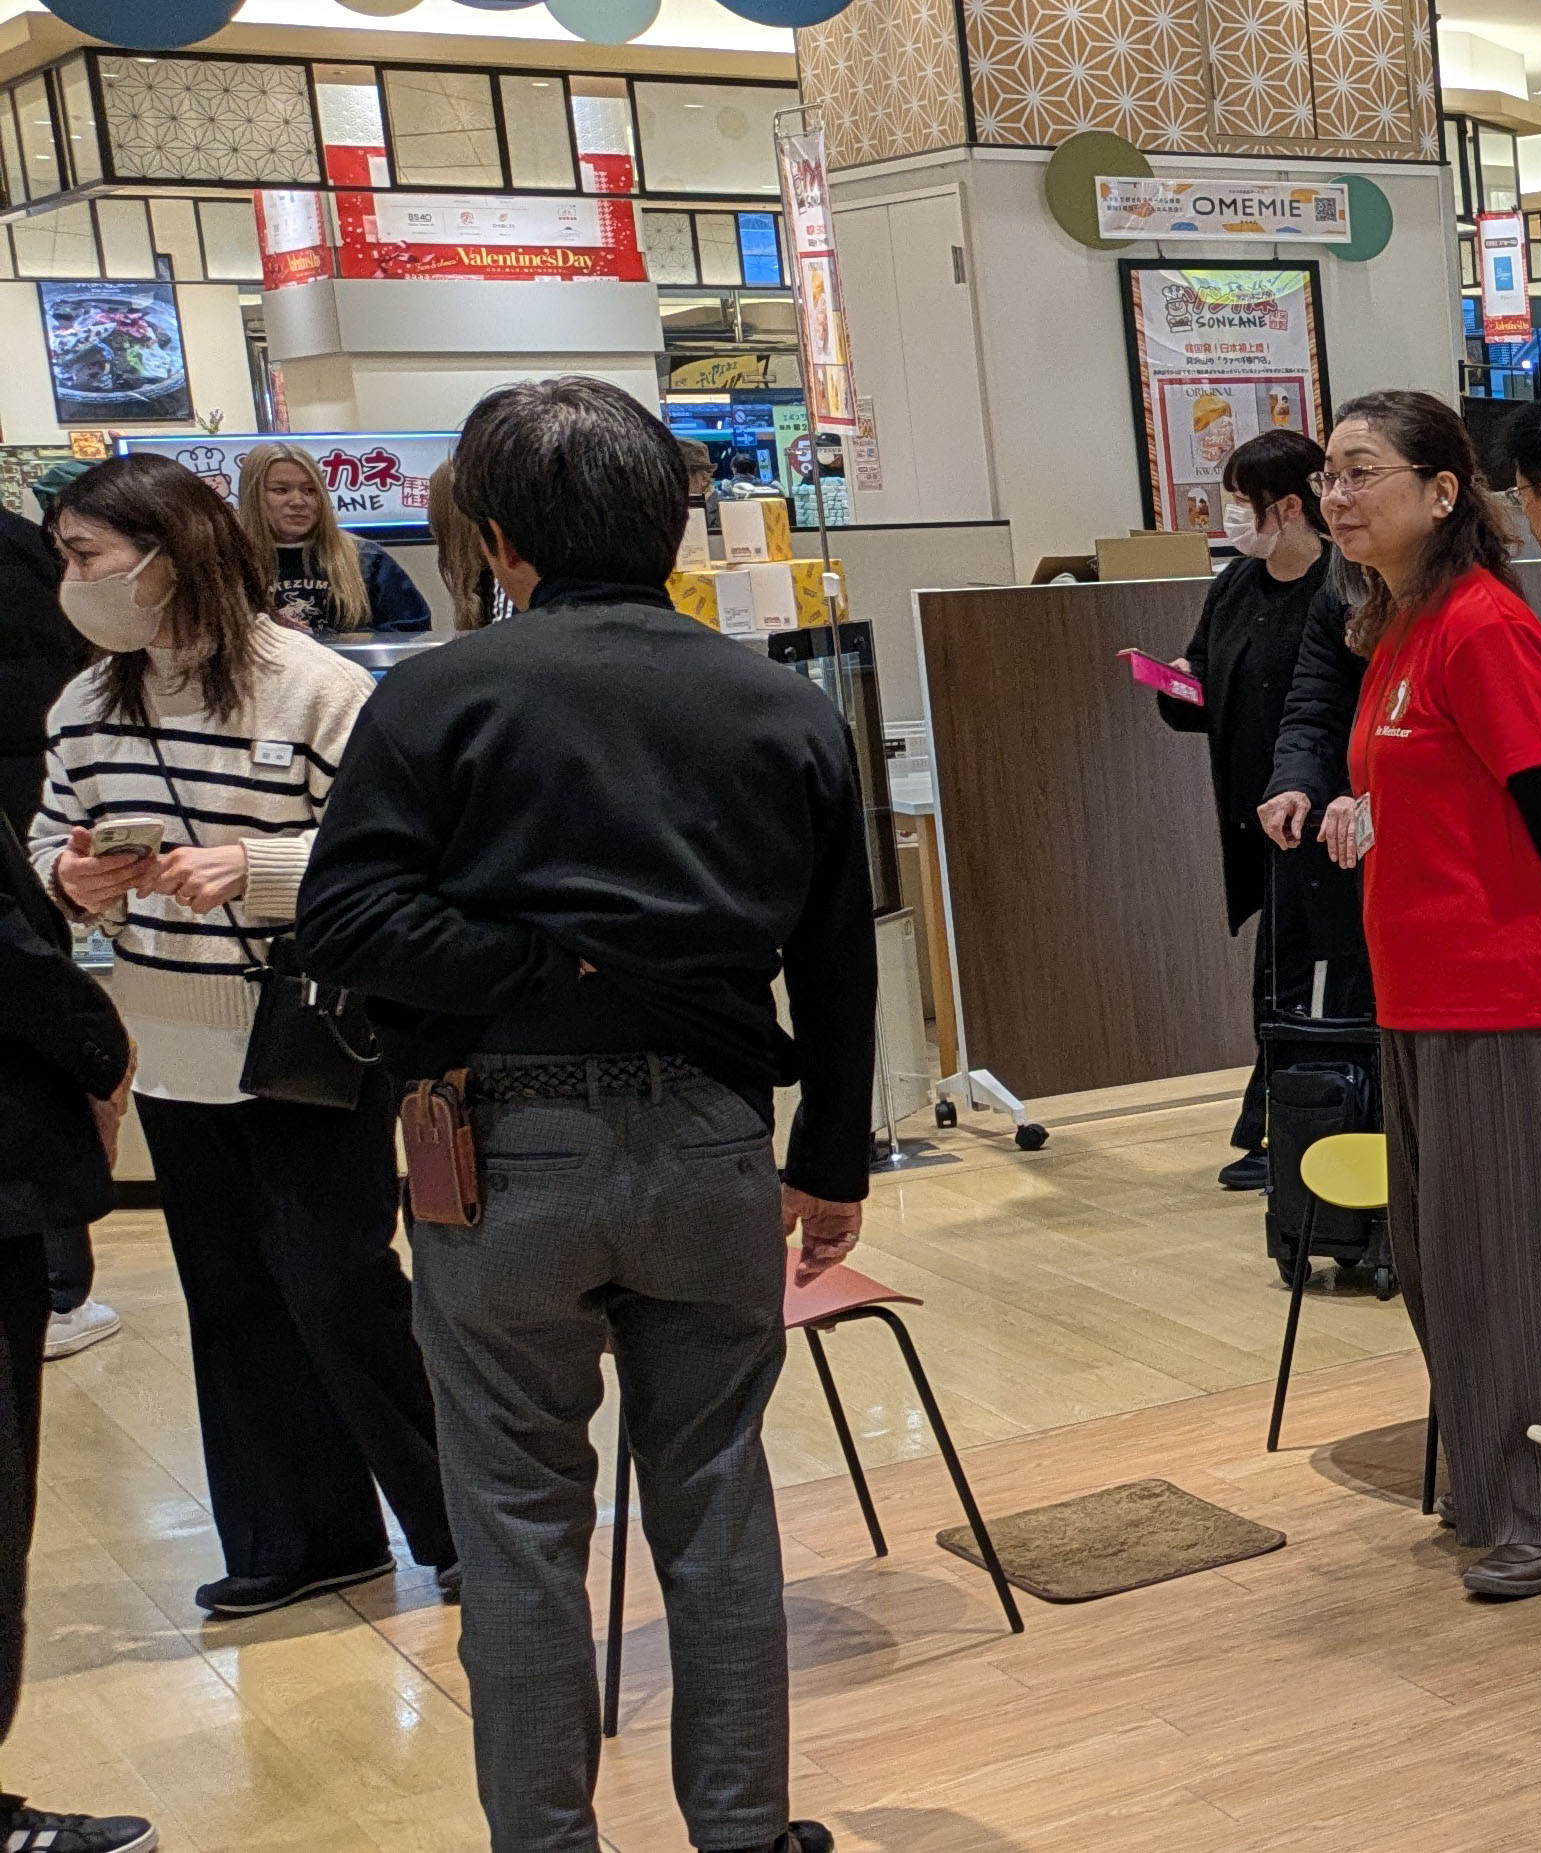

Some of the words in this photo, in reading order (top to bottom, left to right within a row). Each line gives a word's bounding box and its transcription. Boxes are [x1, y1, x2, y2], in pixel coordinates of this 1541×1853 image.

[1193, 197, 1302, 217] OMEMIE
[1196, 315, 1267, 328] SONKANE
[1186, 387, 1232, 397] ORIGINAL
